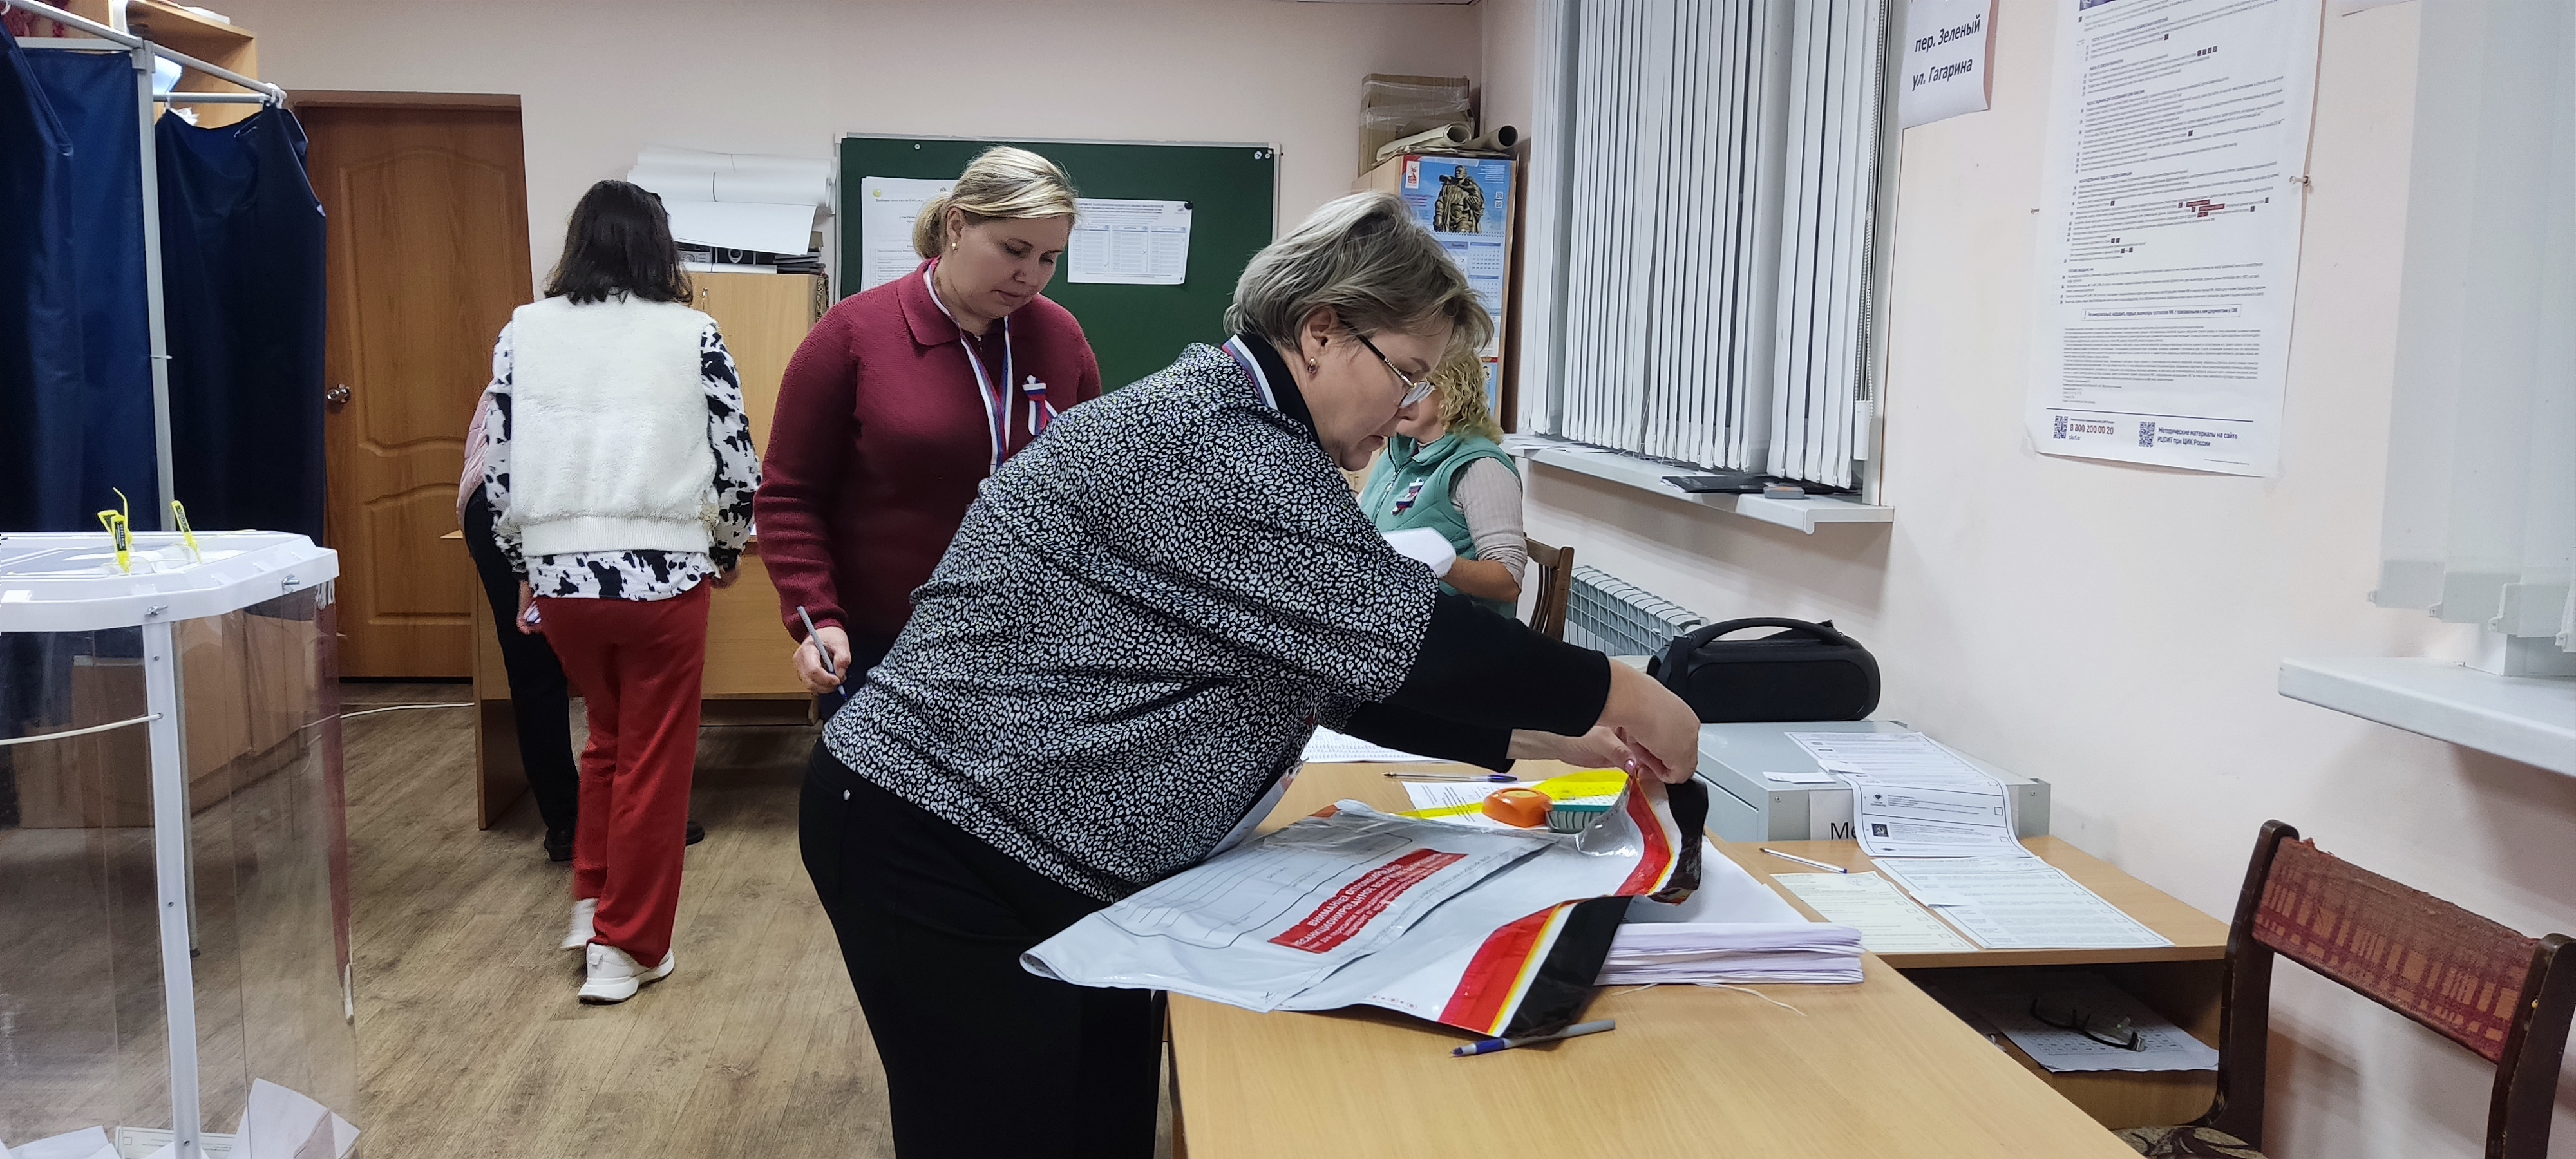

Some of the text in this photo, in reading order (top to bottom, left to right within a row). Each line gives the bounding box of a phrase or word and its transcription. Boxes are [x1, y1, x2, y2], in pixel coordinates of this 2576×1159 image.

[1915, 14, 1980, 53] пер. Зеленый
[1912, 59, 1973, 91] ул. Гагарина
[2075, 424, 2085, 432] 800
[2087, 425, 2097, 433] 200
[2098, 426, 2105, 434] 00
[2107, 426, 2114, 435] 20
